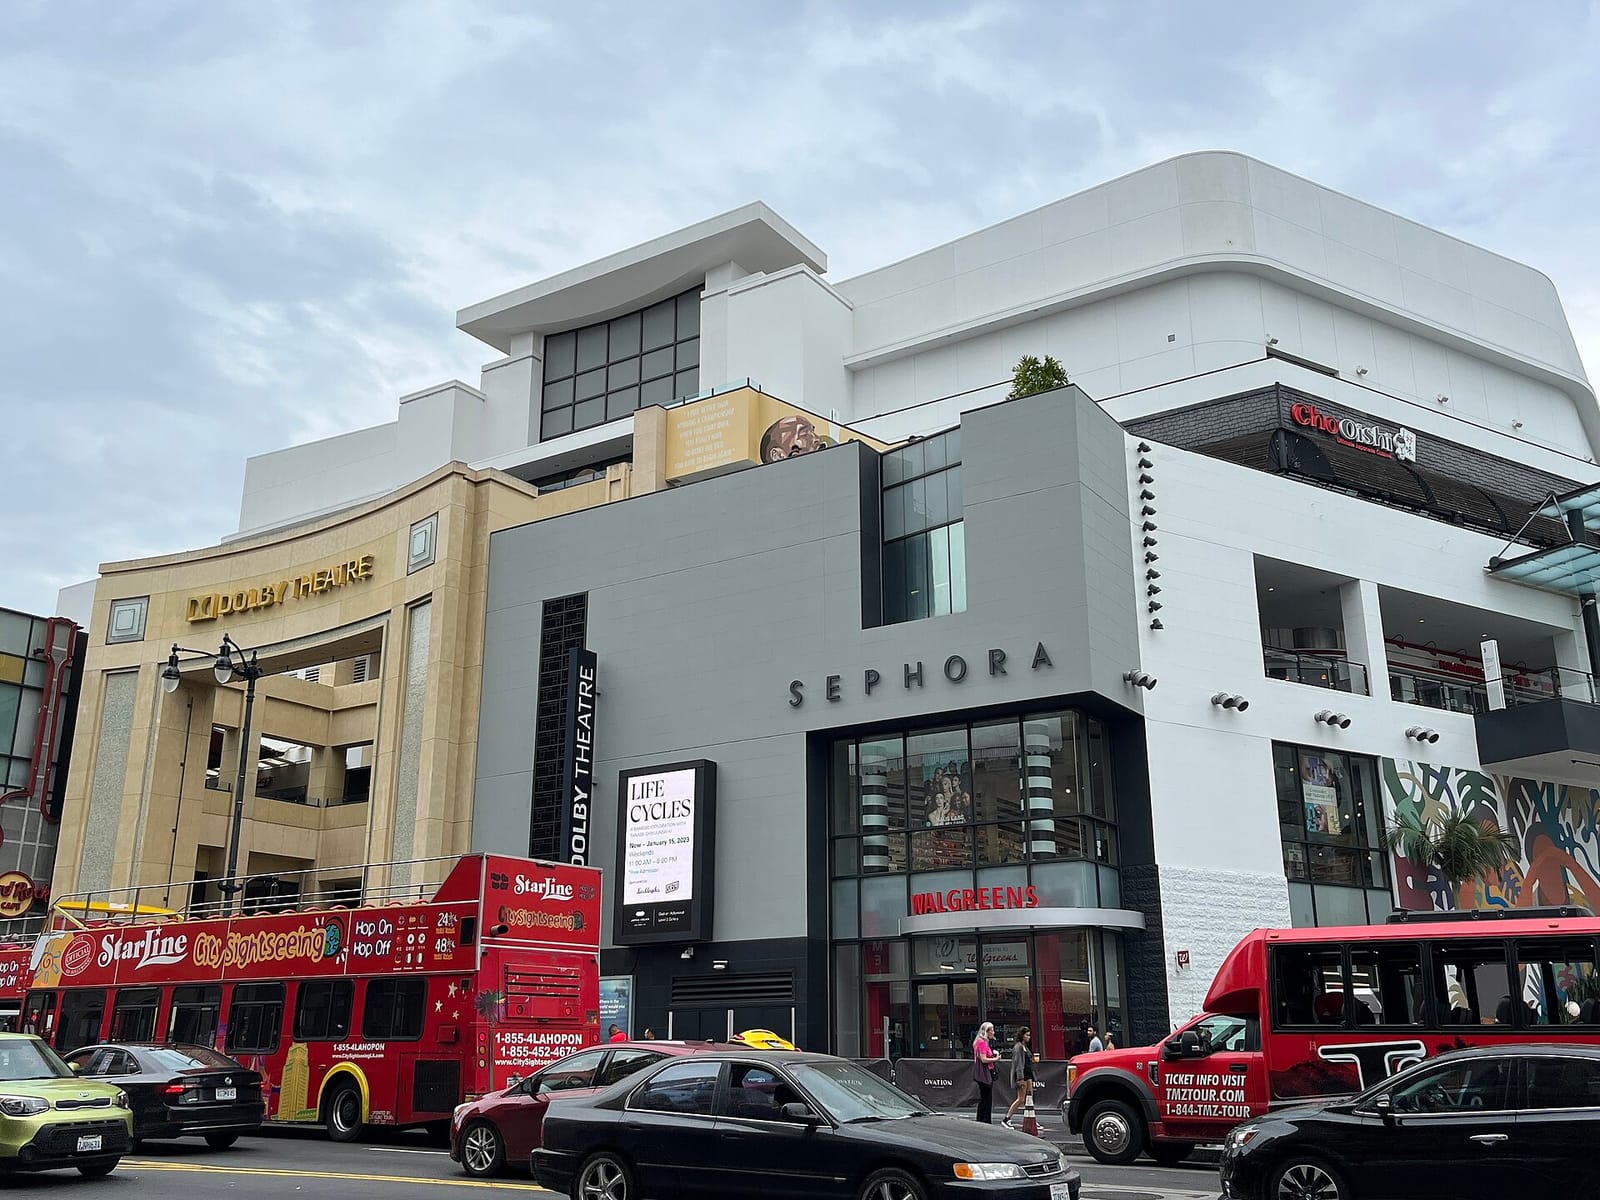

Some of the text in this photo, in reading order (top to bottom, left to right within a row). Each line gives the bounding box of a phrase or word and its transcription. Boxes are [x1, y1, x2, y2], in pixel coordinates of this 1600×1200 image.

[218, 553, 375, 616] DOLBY THEATRE
[789, 641, 1053, 708] SEPHORA
[574, 665, 594, 778] THEATRE
[632, 780, 664, 800] LIFE
[630, 798, 691, 823] CYCLES
[677, 836, 690, 844] 2023
[514, 874, 574, 901] StarLine
[911, 884, 1039, 915] WALGREENS
[355, 919, 393, 937] Hop On
[437, 912, 449, 927] 24
[98, 926, 188, 970] StarLine
[353, 941, 373, 958] Hop
[375, 940, 392, 956] Off
[434, 938, 447, 953] 48
[966, 951, 1019, 966] Wlgreens
[333, 1043, 385, 1051] 1-855-4LAHOPON
[495, 1032, 583, 1045] 1-855-4LAHOPON
[1165, 1073, 1247, 1087] TICKET INFO VISIT
[1166, 1088, 1245, 1103] TMZTOUR.COM
[1166, 1103, 1251, 1118] 1-844-TMZ-TOUR
